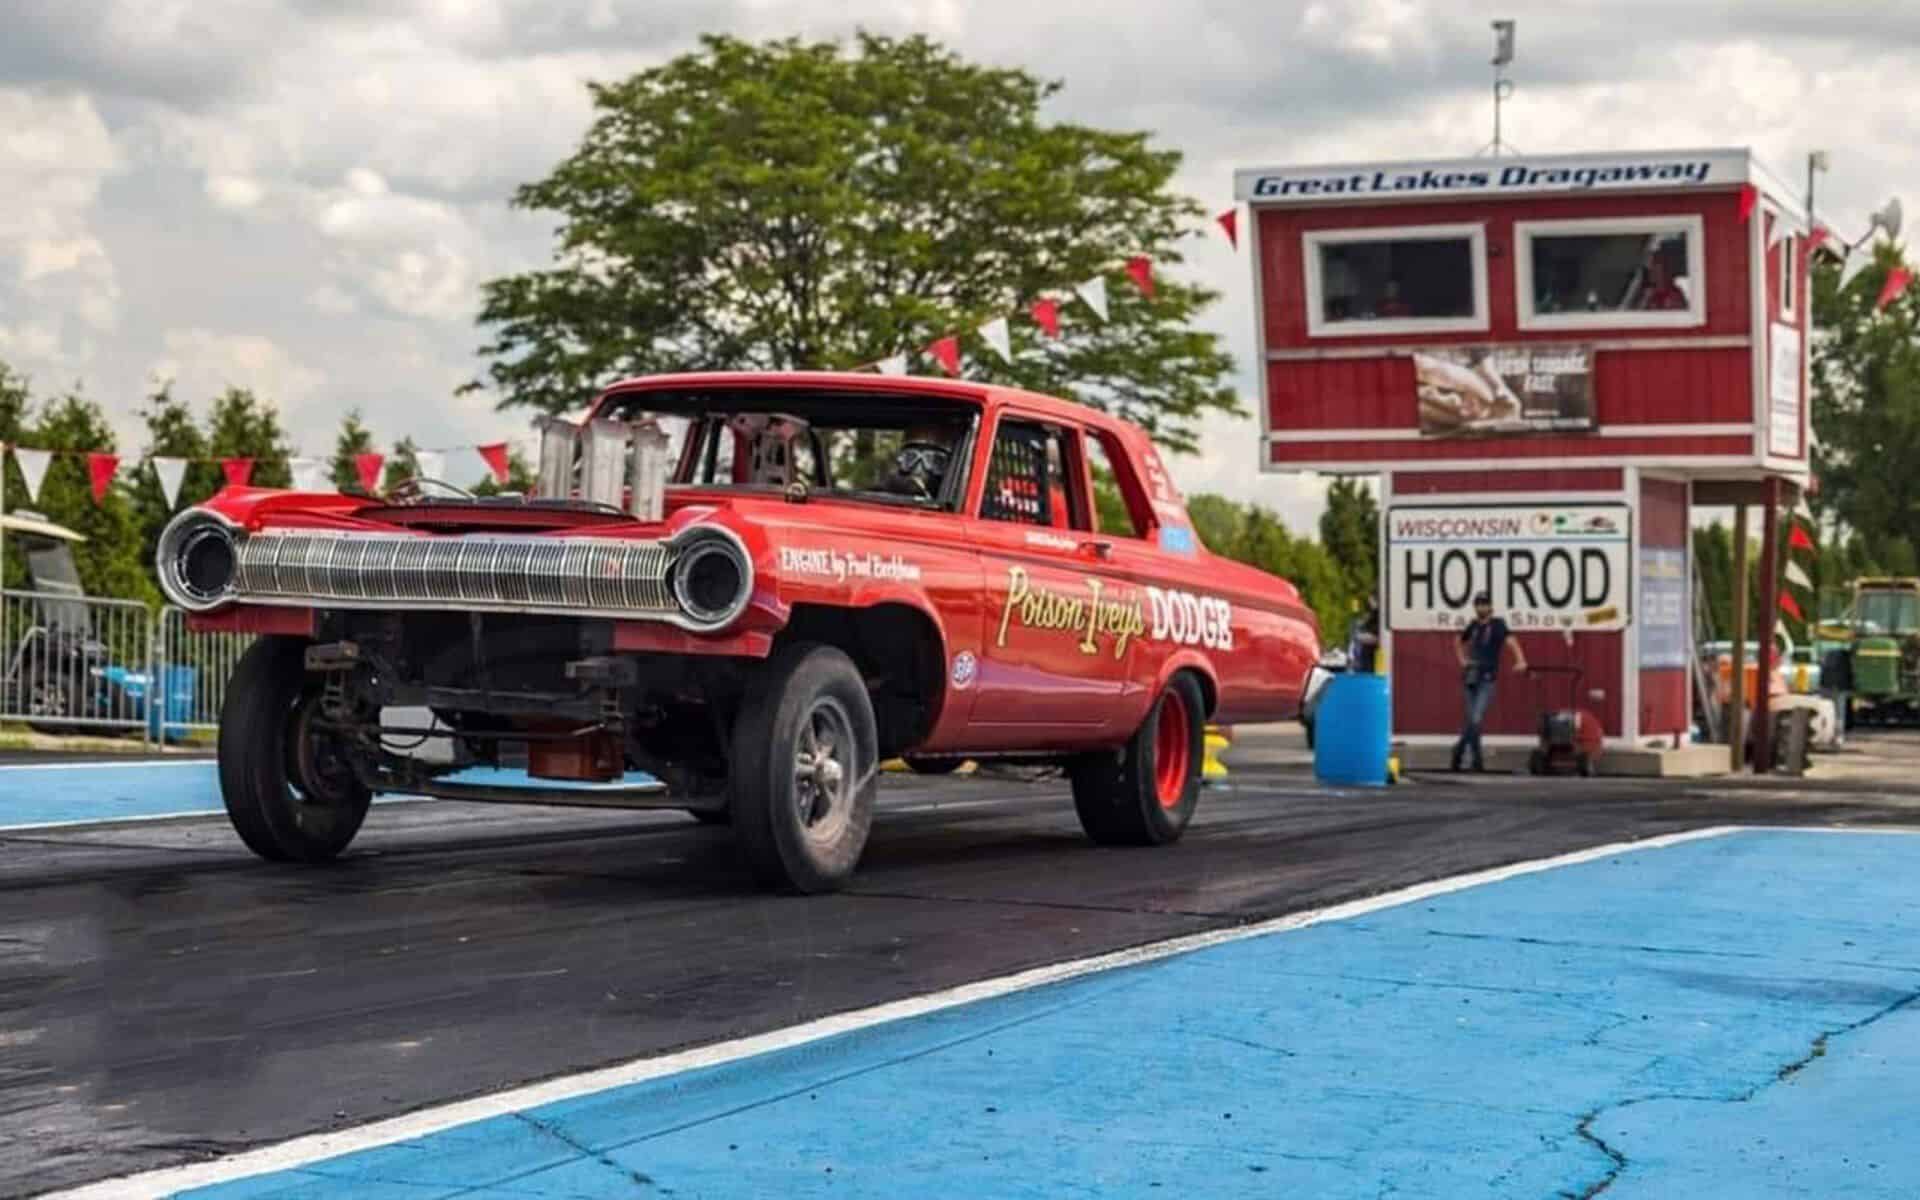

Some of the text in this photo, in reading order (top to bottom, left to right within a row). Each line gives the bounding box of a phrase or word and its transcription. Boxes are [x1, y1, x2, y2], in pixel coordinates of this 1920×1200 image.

[1253, 162, 1710, 197] Great Lakes Dragaway
[1397, 516, 1522, 538] WISCONSIN
[780, 546, 831, 575] ENGINE
[830, 549, 846, 583] by
[1404, 547, 1610, 609] HOTROD
[997, 566, 1085, 647] Poison
[1147, 586, 1233, 652] DODGE
[1511, 611, 1574, 628] Show
